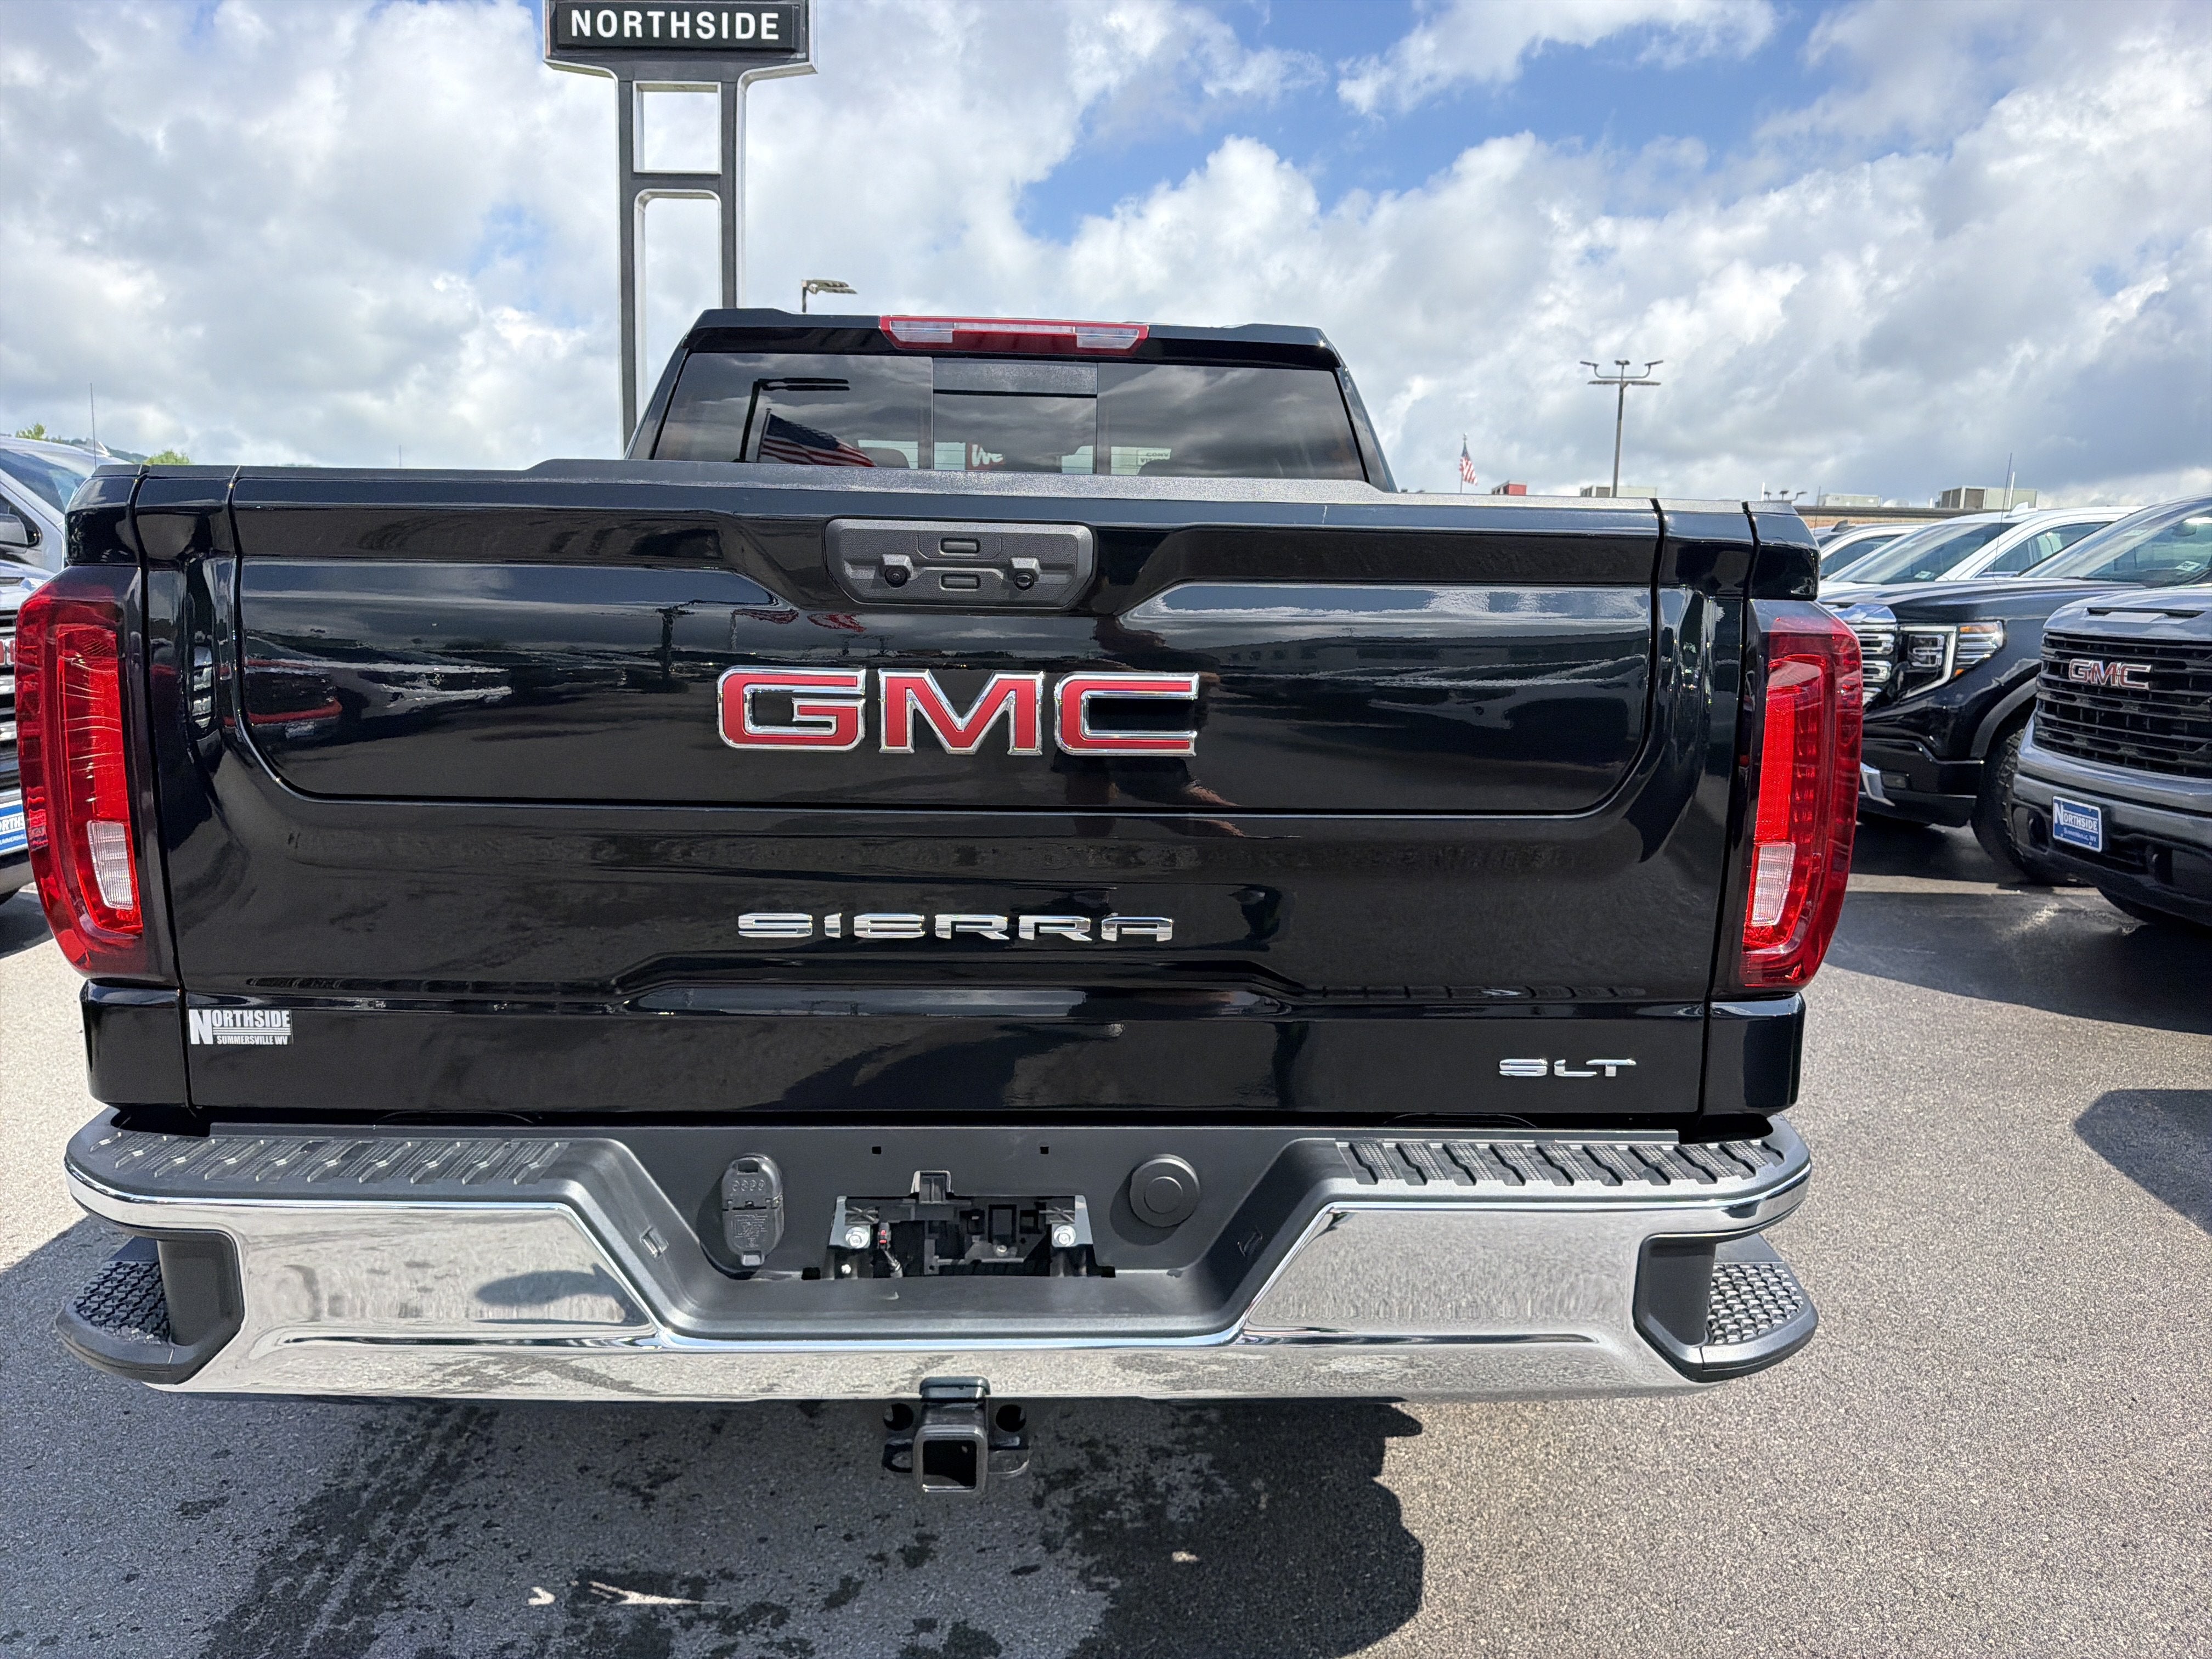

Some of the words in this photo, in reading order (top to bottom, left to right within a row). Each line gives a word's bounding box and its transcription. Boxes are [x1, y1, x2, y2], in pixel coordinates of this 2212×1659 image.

[571, 9, 779, 40] NORTHSIDE
[2068, 658, 2152, 690] GMC
[717, 664, 1199, 756] GMC
[2053, 802, 2098, 831] NORTHSIDE
[738, 912, 1173, 941] SIERRA
[189, 1009, 291, 1045] NORTHSIDE
[217, 1035, 274, 1045] SUMMERSVILLE
[275, 1036, 288, 1045] WV
[1499, 1058, 1637, 1077] SLT
